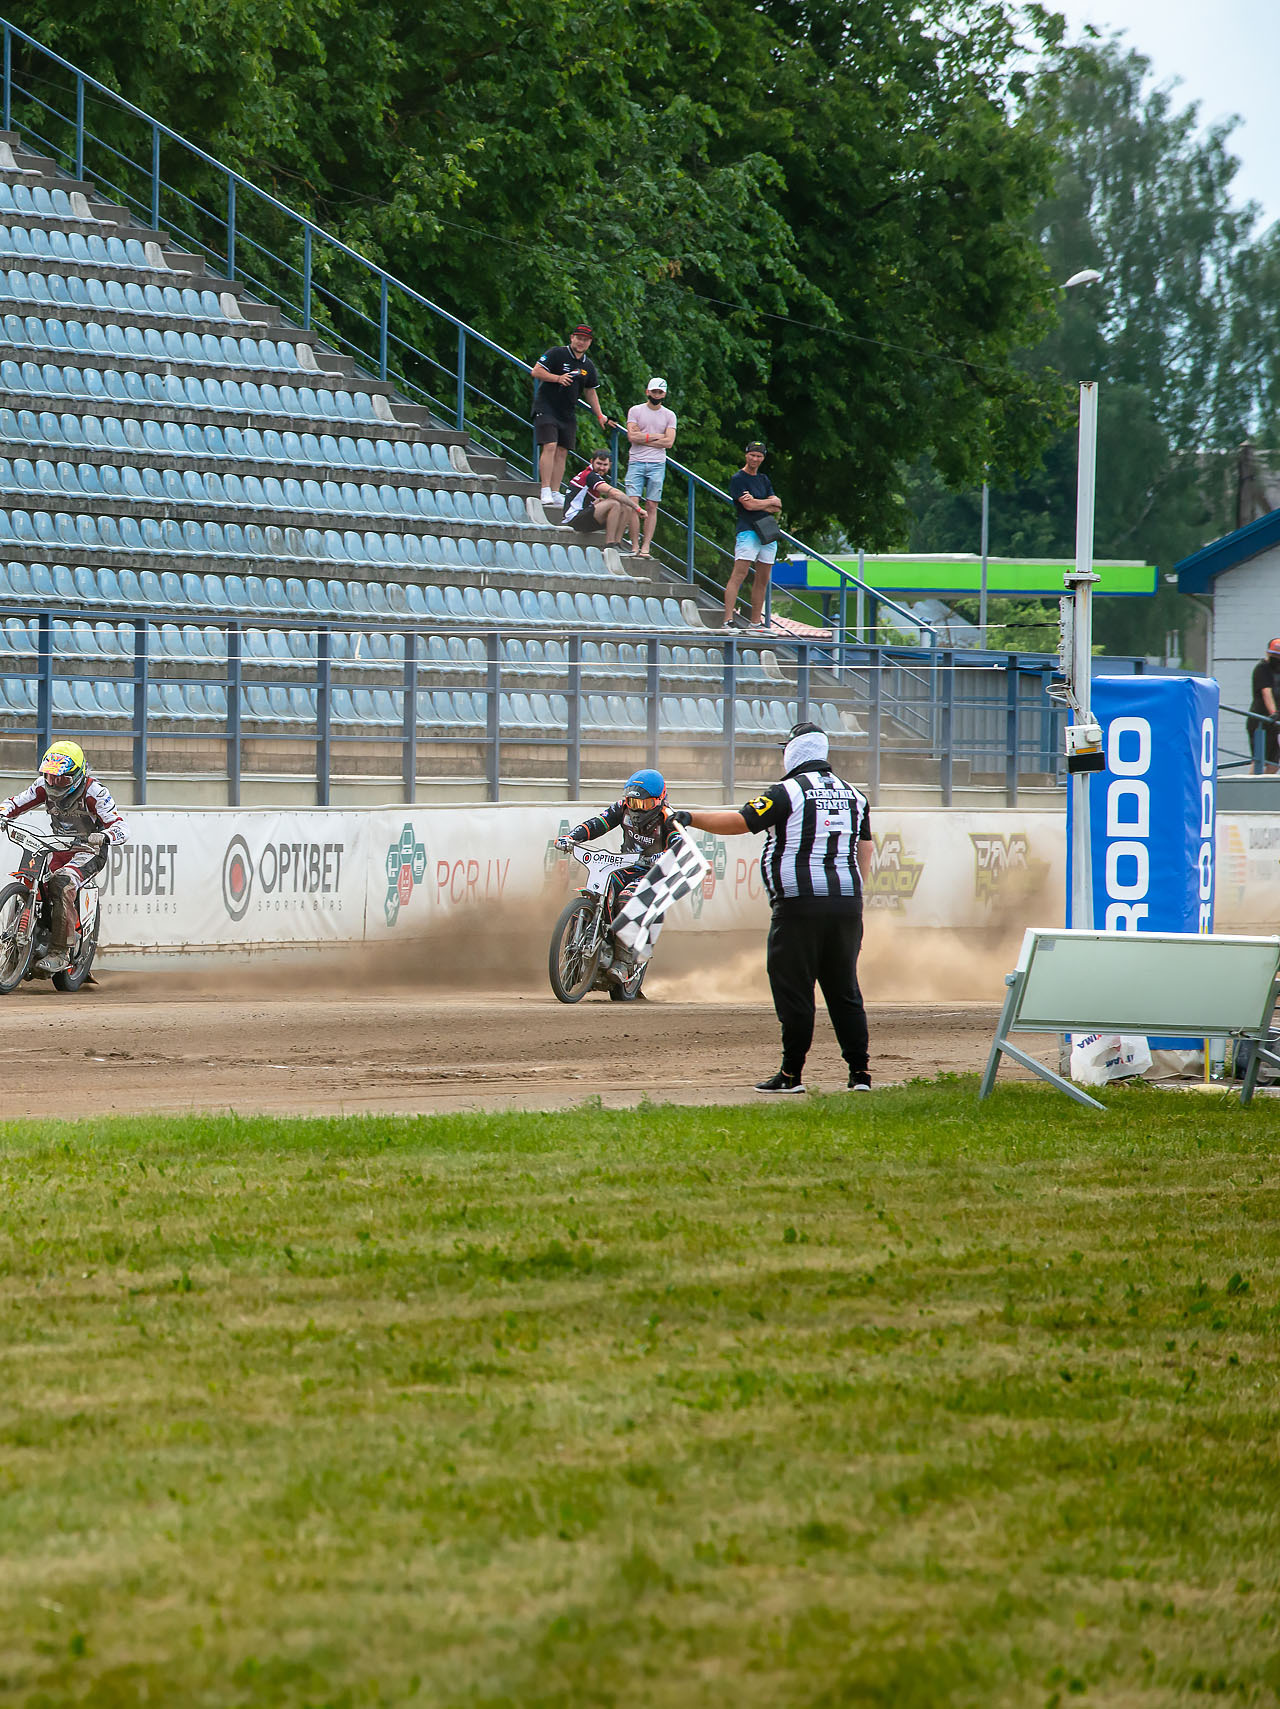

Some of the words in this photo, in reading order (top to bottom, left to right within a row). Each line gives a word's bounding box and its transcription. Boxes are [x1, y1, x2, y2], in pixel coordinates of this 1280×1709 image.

[816, 799, 850, 810] STARTU
[259, 842, 344, 894] OPTIBET
[593, 853, 624, 864] OPTIBET
[436, 858, 510, 905] PCR.LV
